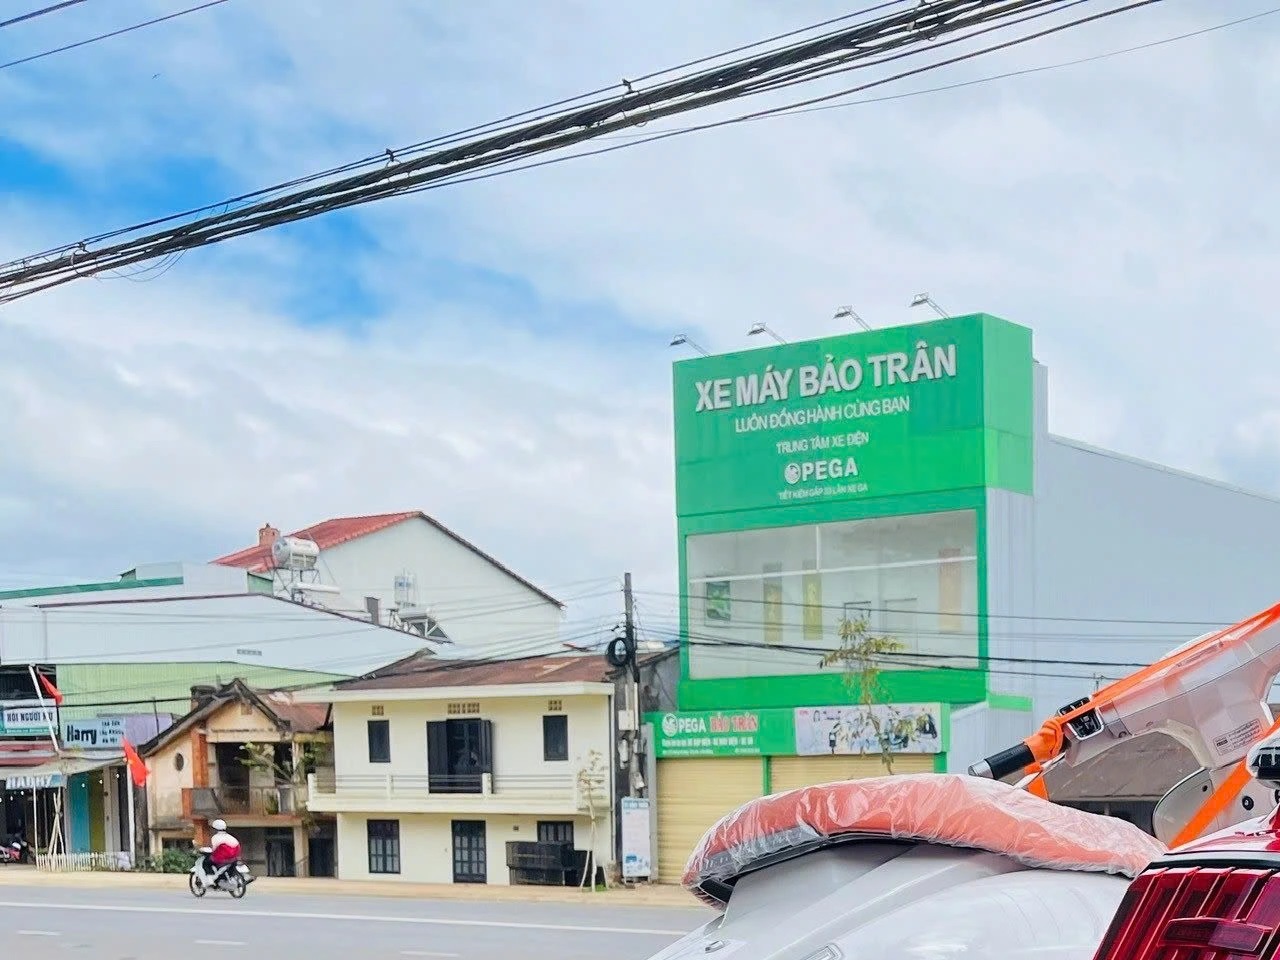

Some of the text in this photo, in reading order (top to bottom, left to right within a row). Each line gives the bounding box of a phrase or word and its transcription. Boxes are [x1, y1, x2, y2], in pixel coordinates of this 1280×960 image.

[694, 340, 958, 412] XE MÁY BẢO TRÂN
[734, 413, 768, 433] LUÔN
[806, 404, 842, 424] HÀNH
[843, 399, 881, 420] CÙNG
[882, 395, 911, 415] BẠN
[775, 440, 808, 454] TRUNG
[831, 435, 846, 448] XE
[801, 457, 859, 483] PEGA
[66, 724, 97, 745] Harry
[678, 717, 707, 733] PEGA
